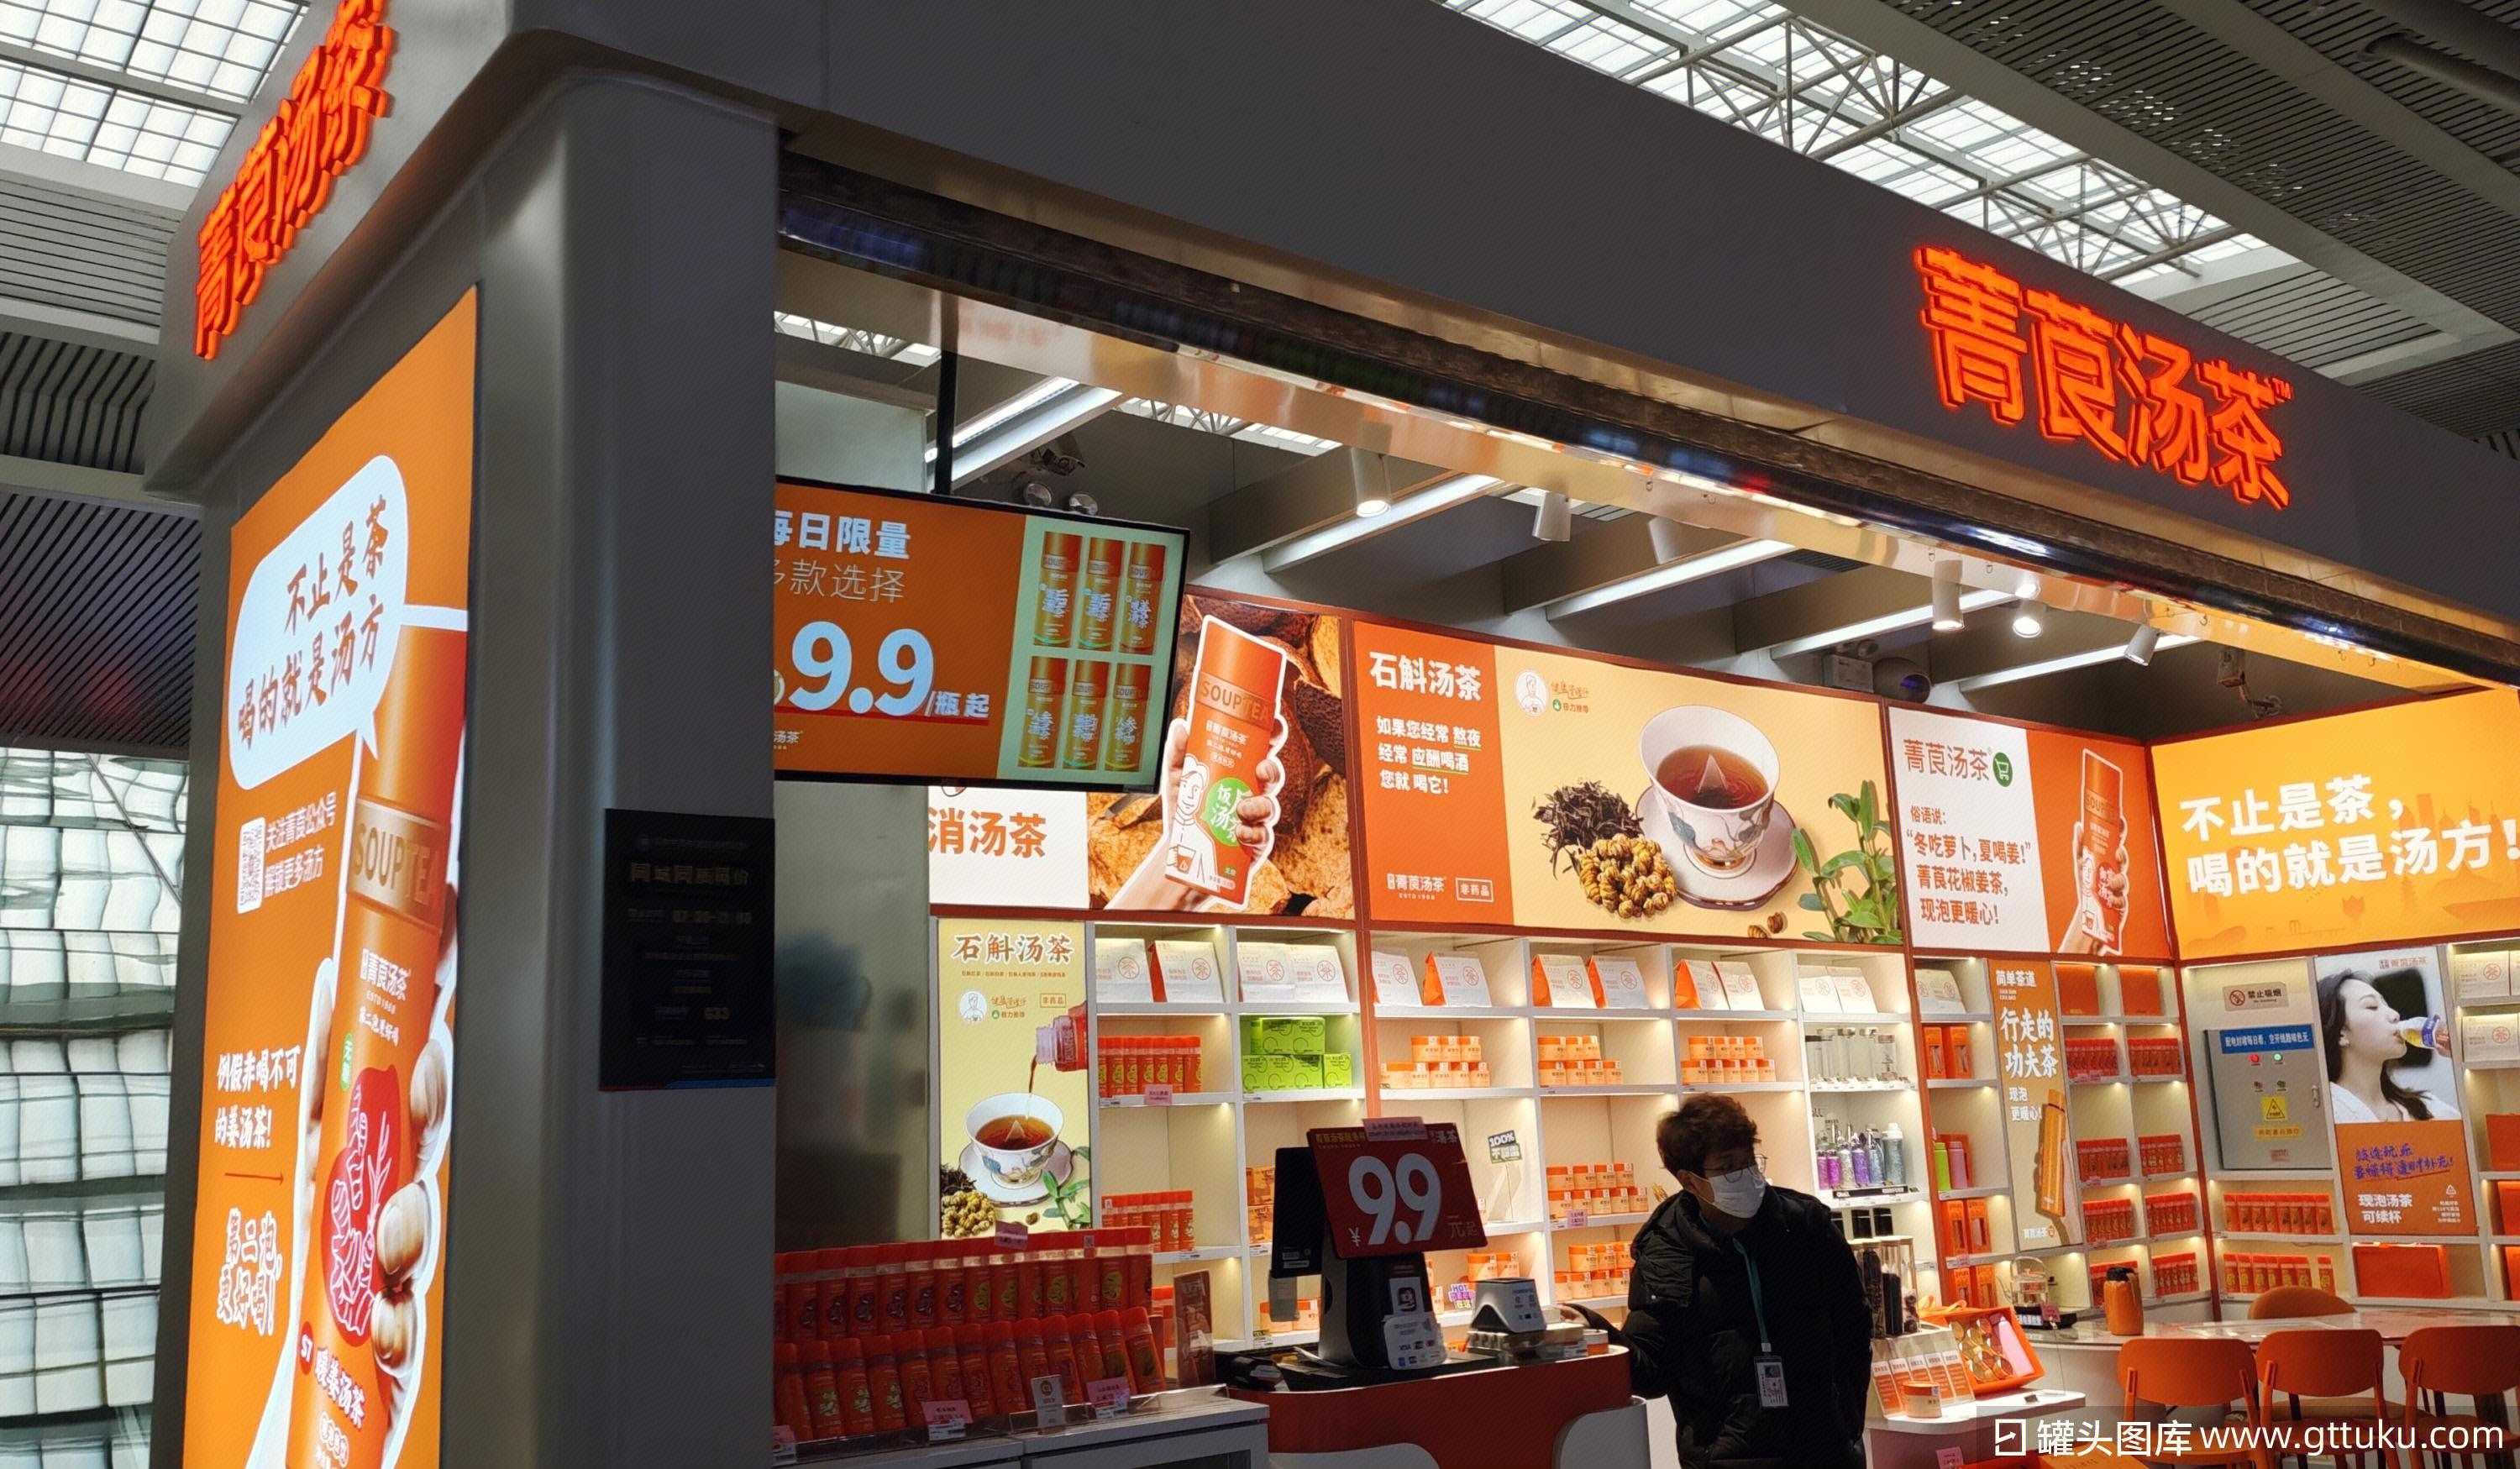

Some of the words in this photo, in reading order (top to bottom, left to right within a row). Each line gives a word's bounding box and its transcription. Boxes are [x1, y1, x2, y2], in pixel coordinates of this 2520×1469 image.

[284, 494, 389, 636] 不止是茶
[238, 593, 384, 750] 喝的就是汤方
[788, 621, 935, 717] 9.9
[1369, 652, 1482, 702] 石斛汤茶
[1377, 716, 1449, 742] 如果您经常
[1453, 726, 1482, 748] 熬夜
[1378, 742, 1408, 763] 经常
[1412, 748, 1470, 772] 应酬喝酒
[1380, 769, 1410, 790] 您就
[2179, 774, 2405, 842] 不止是茶，
[928, 806, 1047, 858] 消汤茶
[953, 933, 1074, 963] 石斛汤茶
[2247, 988, 2282, 999] 禁止吸烟
[2000, 1006, 2055, 1042] 行走的
[2005, 1043, 2058, 1078] 功夫茶
[2009, 1086, 2028, 1102] 现泡
[1348, 1152, 1442, 1246] 9.9
[2357, 1194, 2412, 1208] 现泡汤茶
[2361, 1209, 2402, 1224] 可续杯
